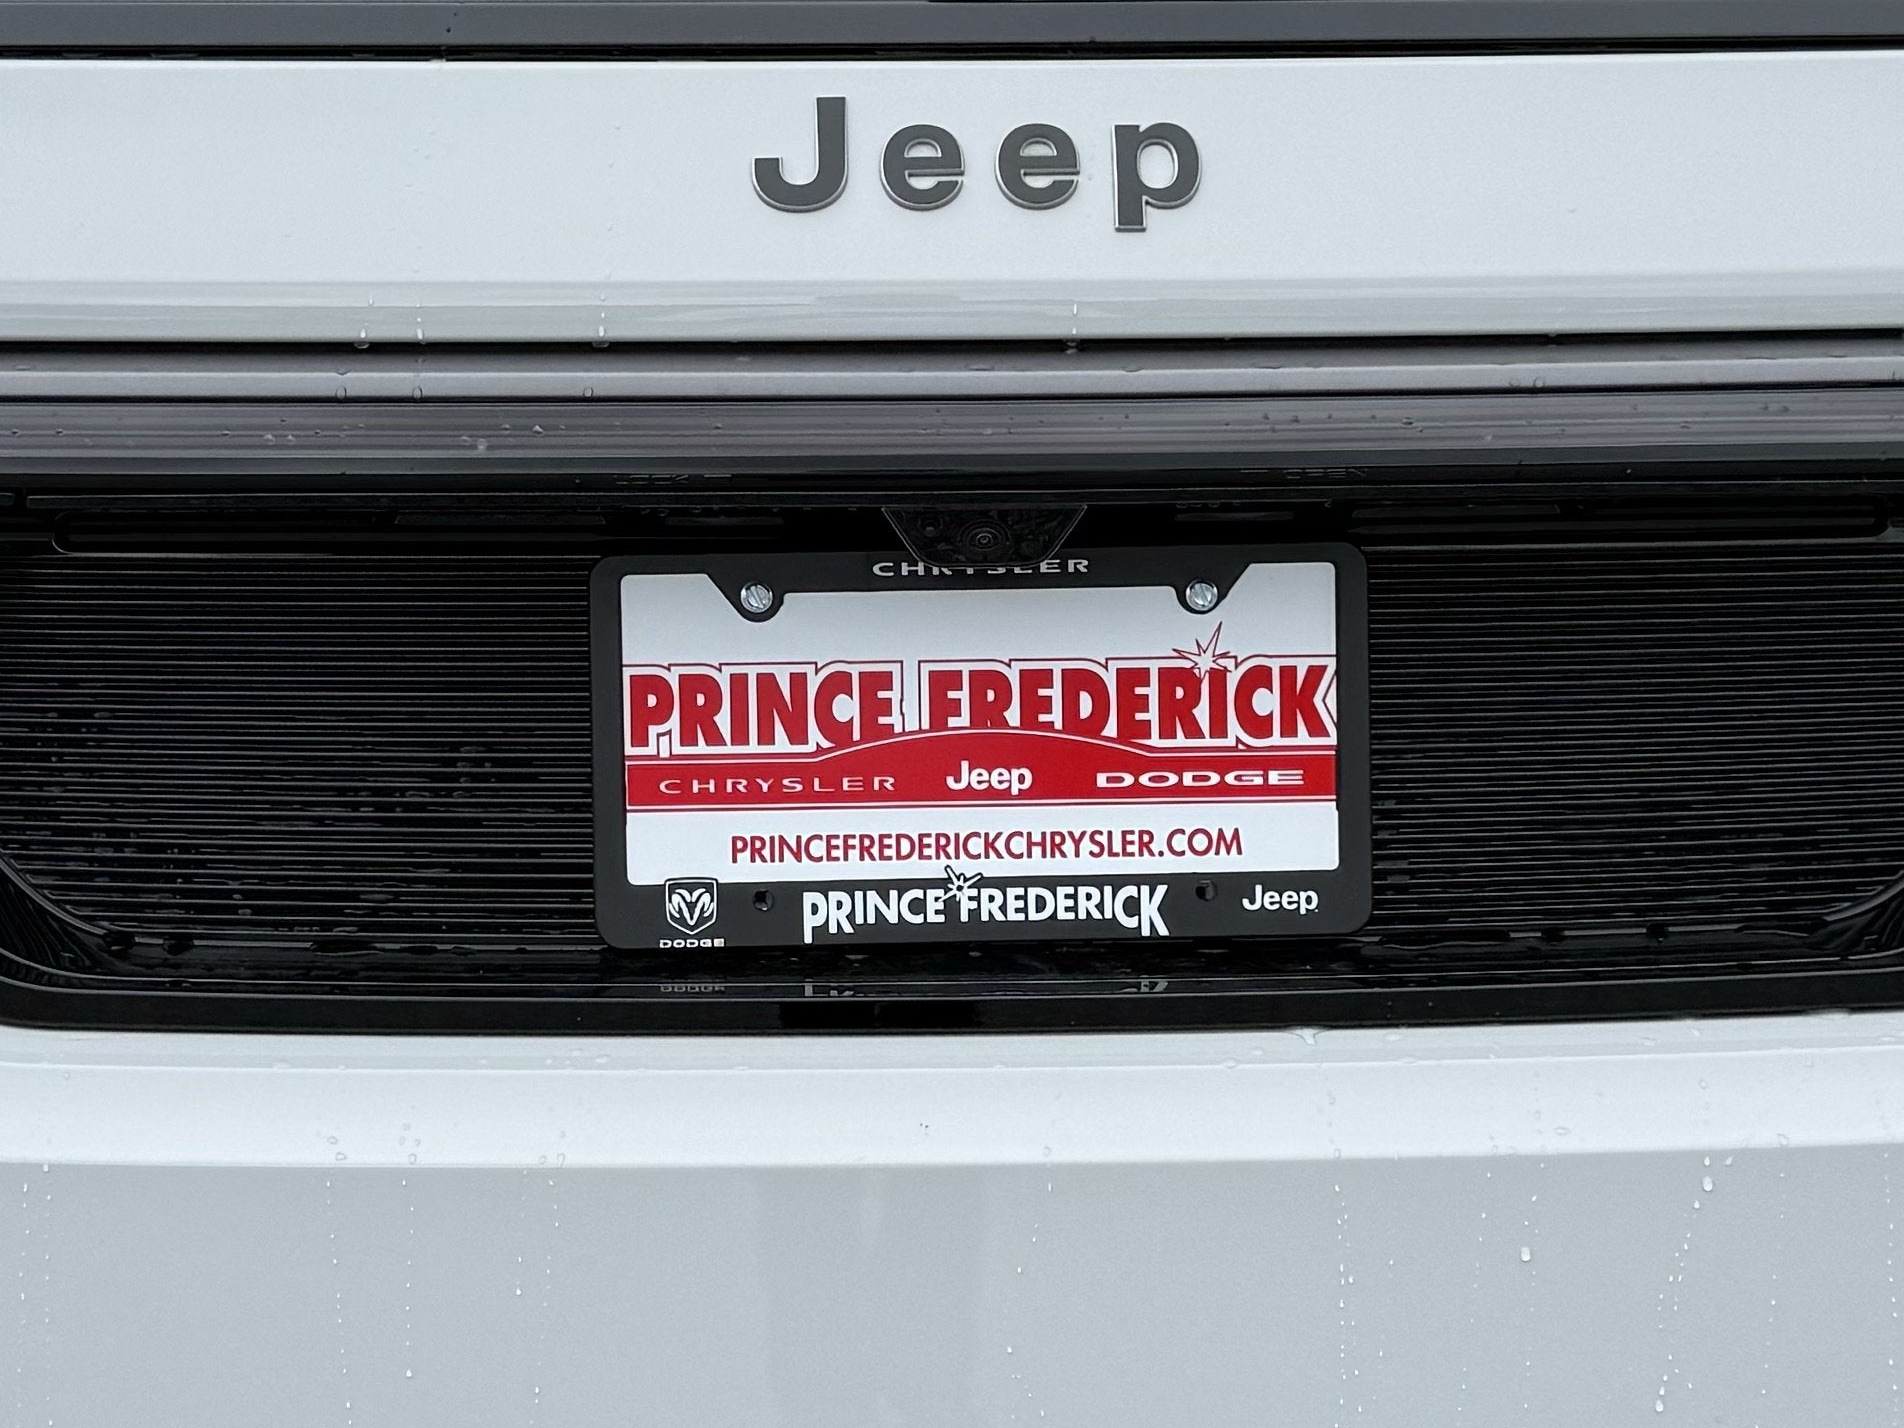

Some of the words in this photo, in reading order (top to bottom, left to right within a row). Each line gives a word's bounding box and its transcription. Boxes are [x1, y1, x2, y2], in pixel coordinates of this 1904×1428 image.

[752, 95, 1202, 232] Jeep
[629, 669, 895, 748] PRINCE
[927, 664, 1335, 740] FREDERICK
[658, 775, 896, 795] CHRYSLER
[945, 760, 1033, 796] Jeep
[1095, 769, 1305, 789] DODGE
[731, 827, 1244, 864] PRINCEFREDERICKCHRYSLER.COM
[802, 888, 945, 944] PRINCE
[959, 884, 1170, 937] FREDERICK
[1242, 884, 1319, 915] Jeep
[659, 937, 725, 949] DODGE
